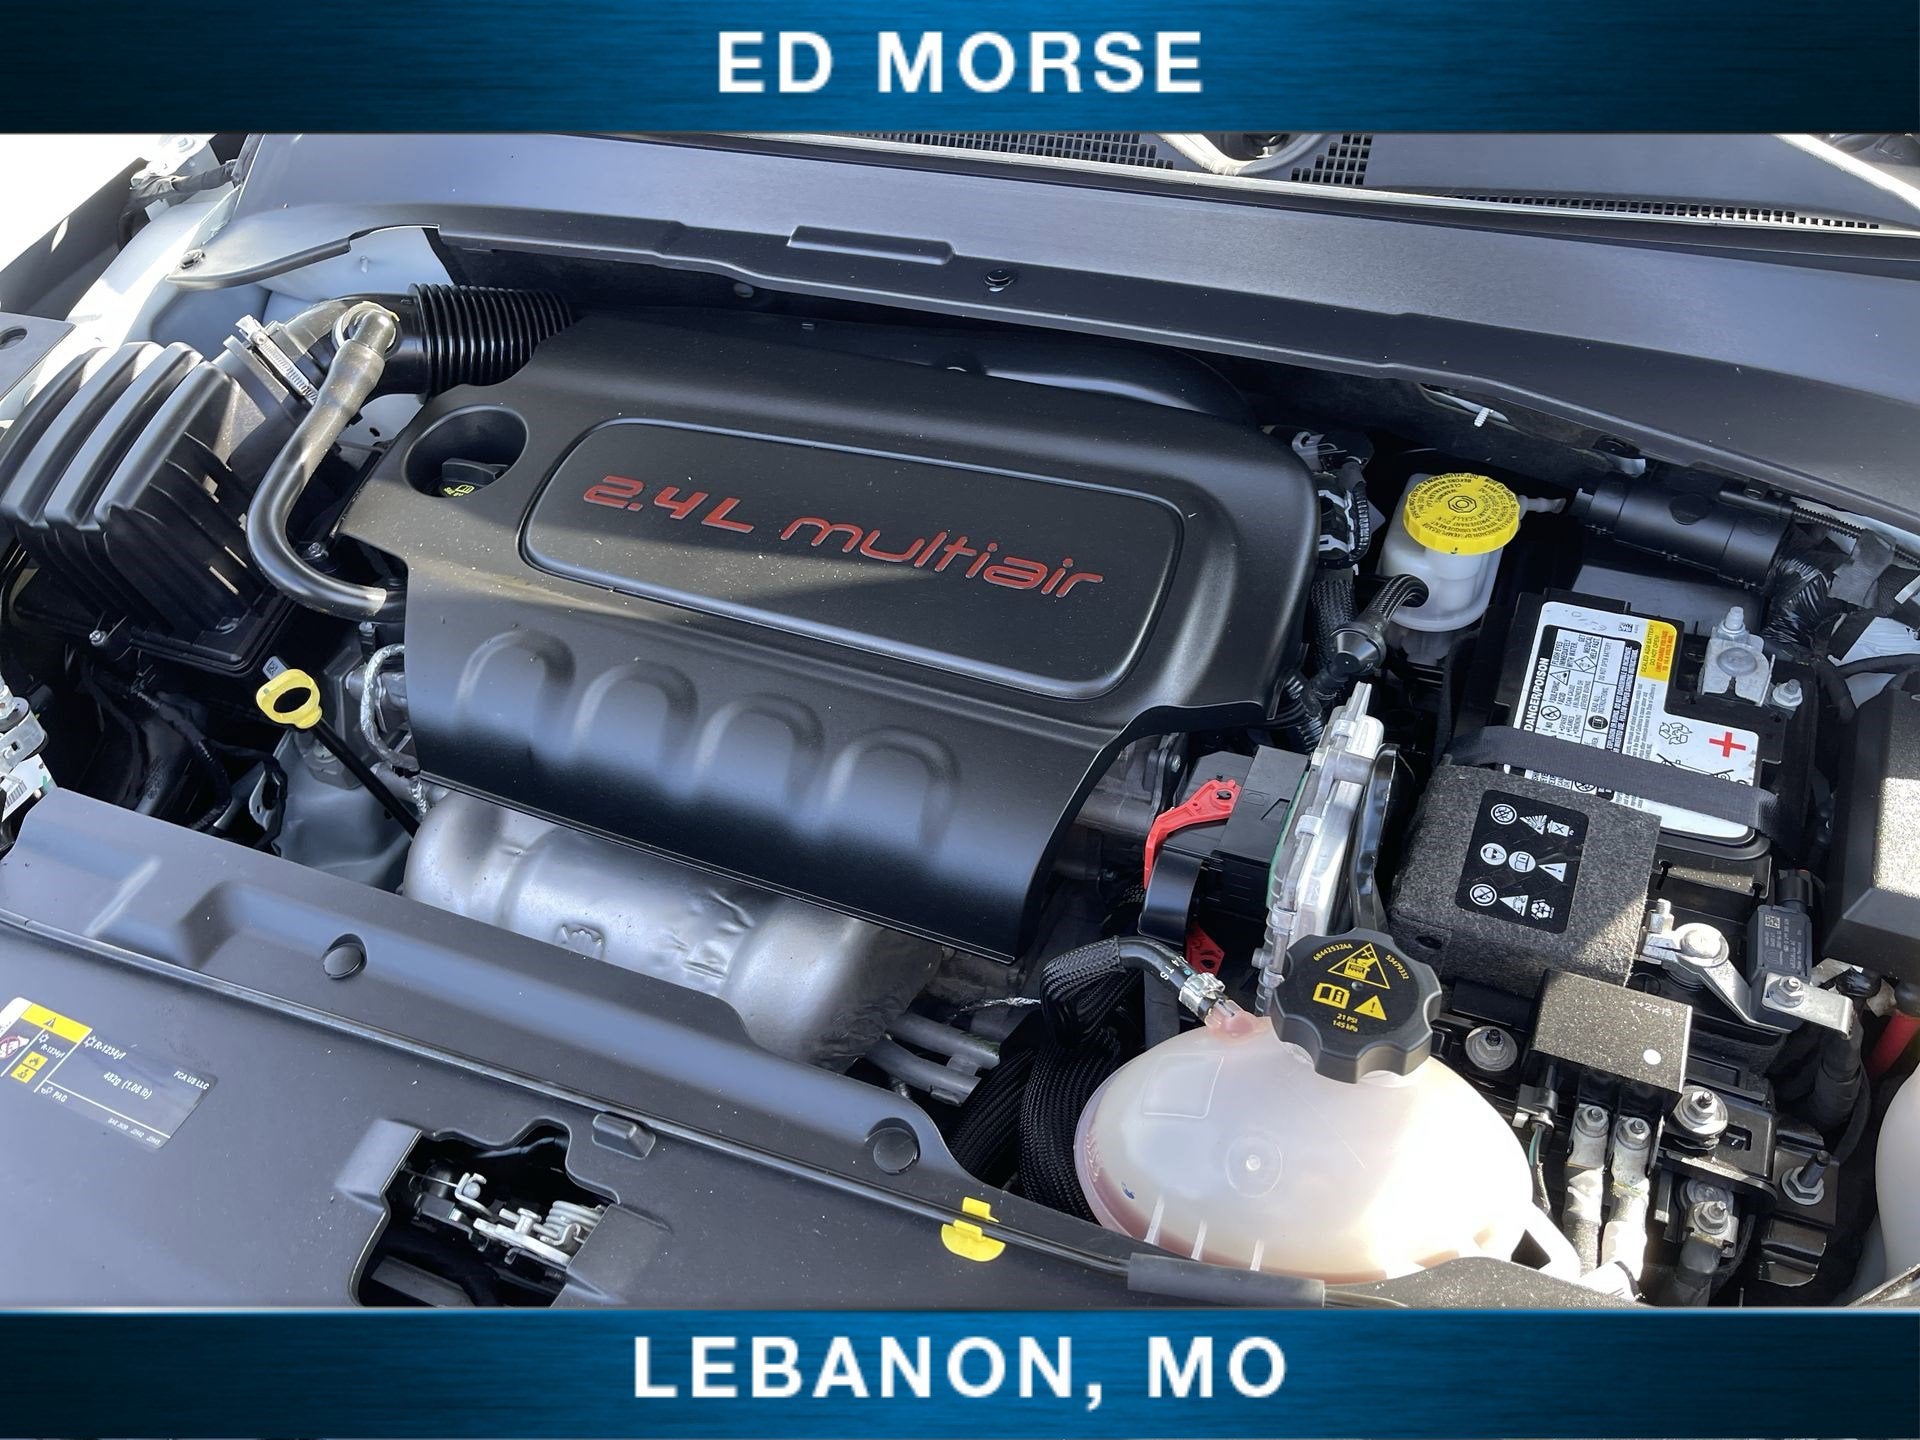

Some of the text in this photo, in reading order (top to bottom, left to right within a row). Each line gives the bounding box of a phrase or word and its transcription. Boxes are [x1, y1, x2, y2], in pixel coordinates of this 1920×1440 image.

[583, 474, 1104, 598] 2.4L multiair
[1523, 656, 1550, 732] DANGER/POISON
[52, 1089, 68, 1103] PAG
[173, 1070, 189, 1084] FCA
[194, 1079, 210, 1091] LLC
